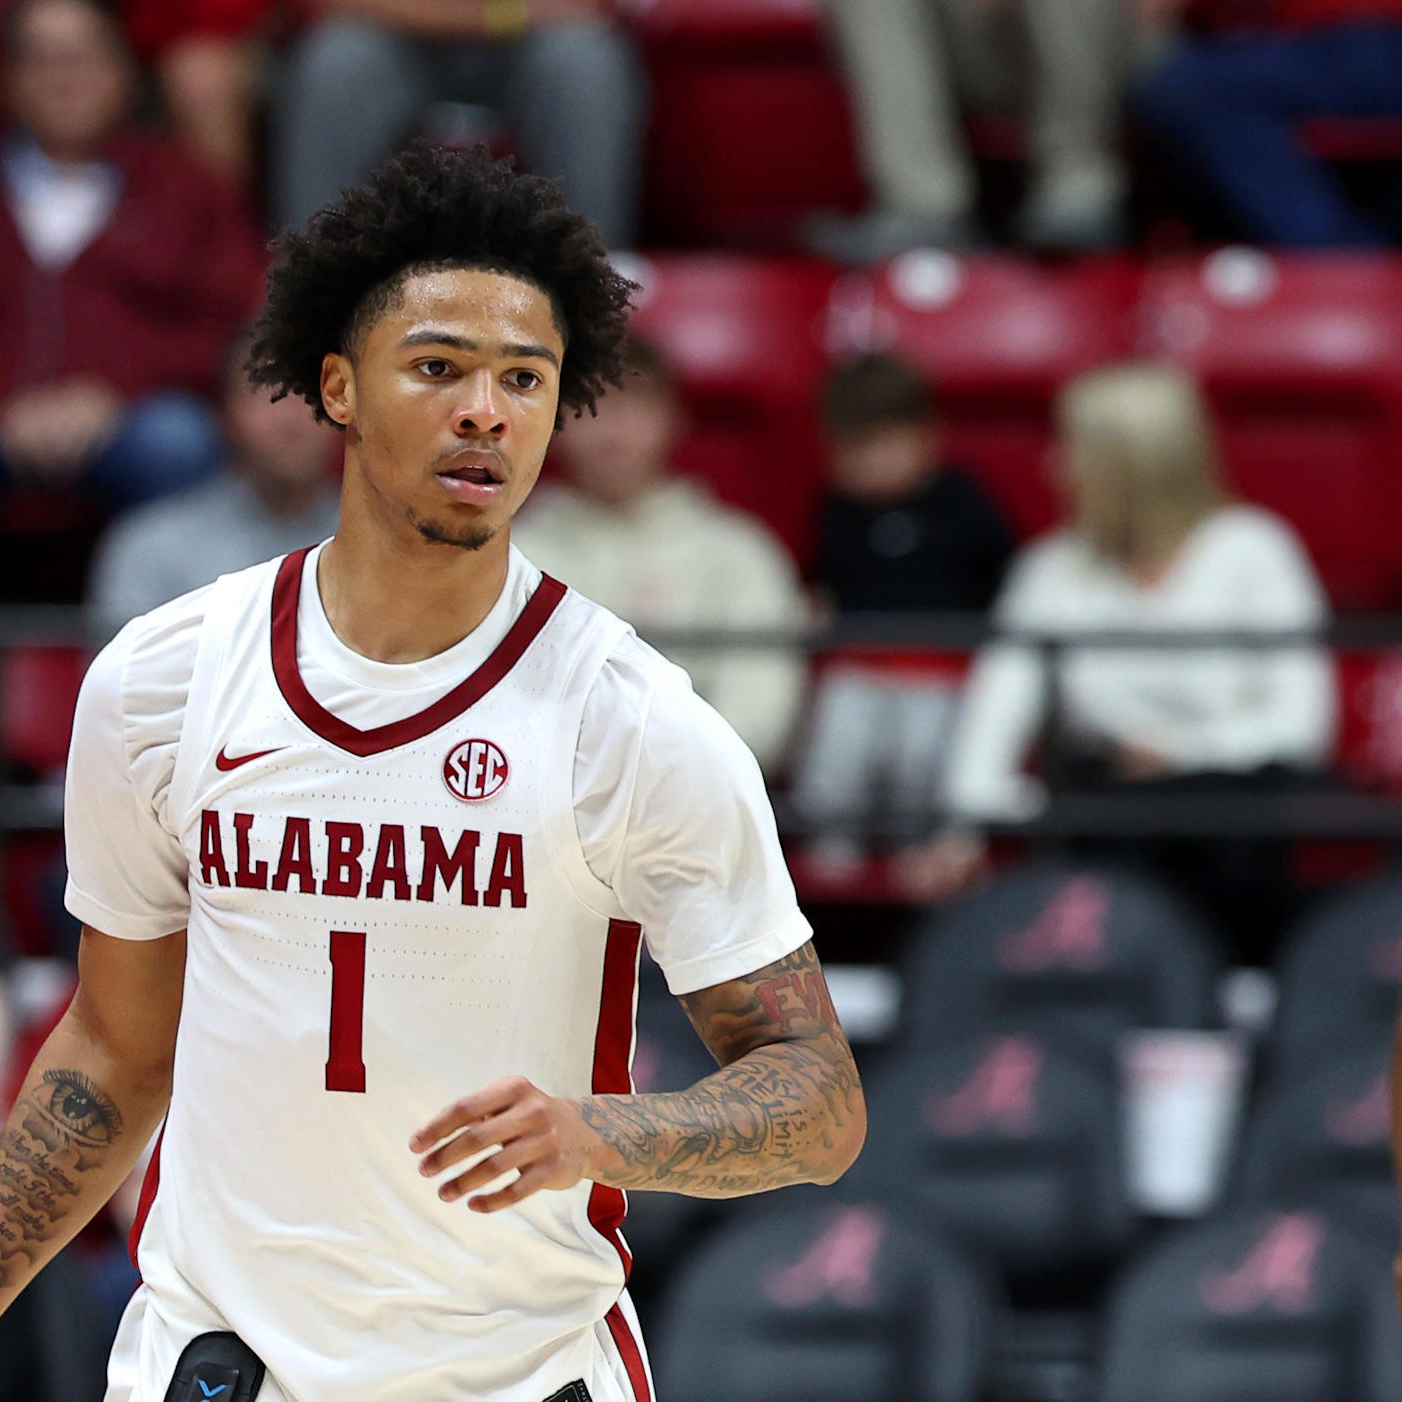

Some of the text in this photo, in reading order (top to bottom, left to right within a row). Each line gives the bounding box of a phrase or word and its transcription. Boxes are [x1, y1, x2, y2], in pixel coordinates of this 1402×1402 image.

[446, 742, 507, 797] SEC
[199, 809, 527, 909] ALABAMA
[325, 930, 366, 1093] 1
